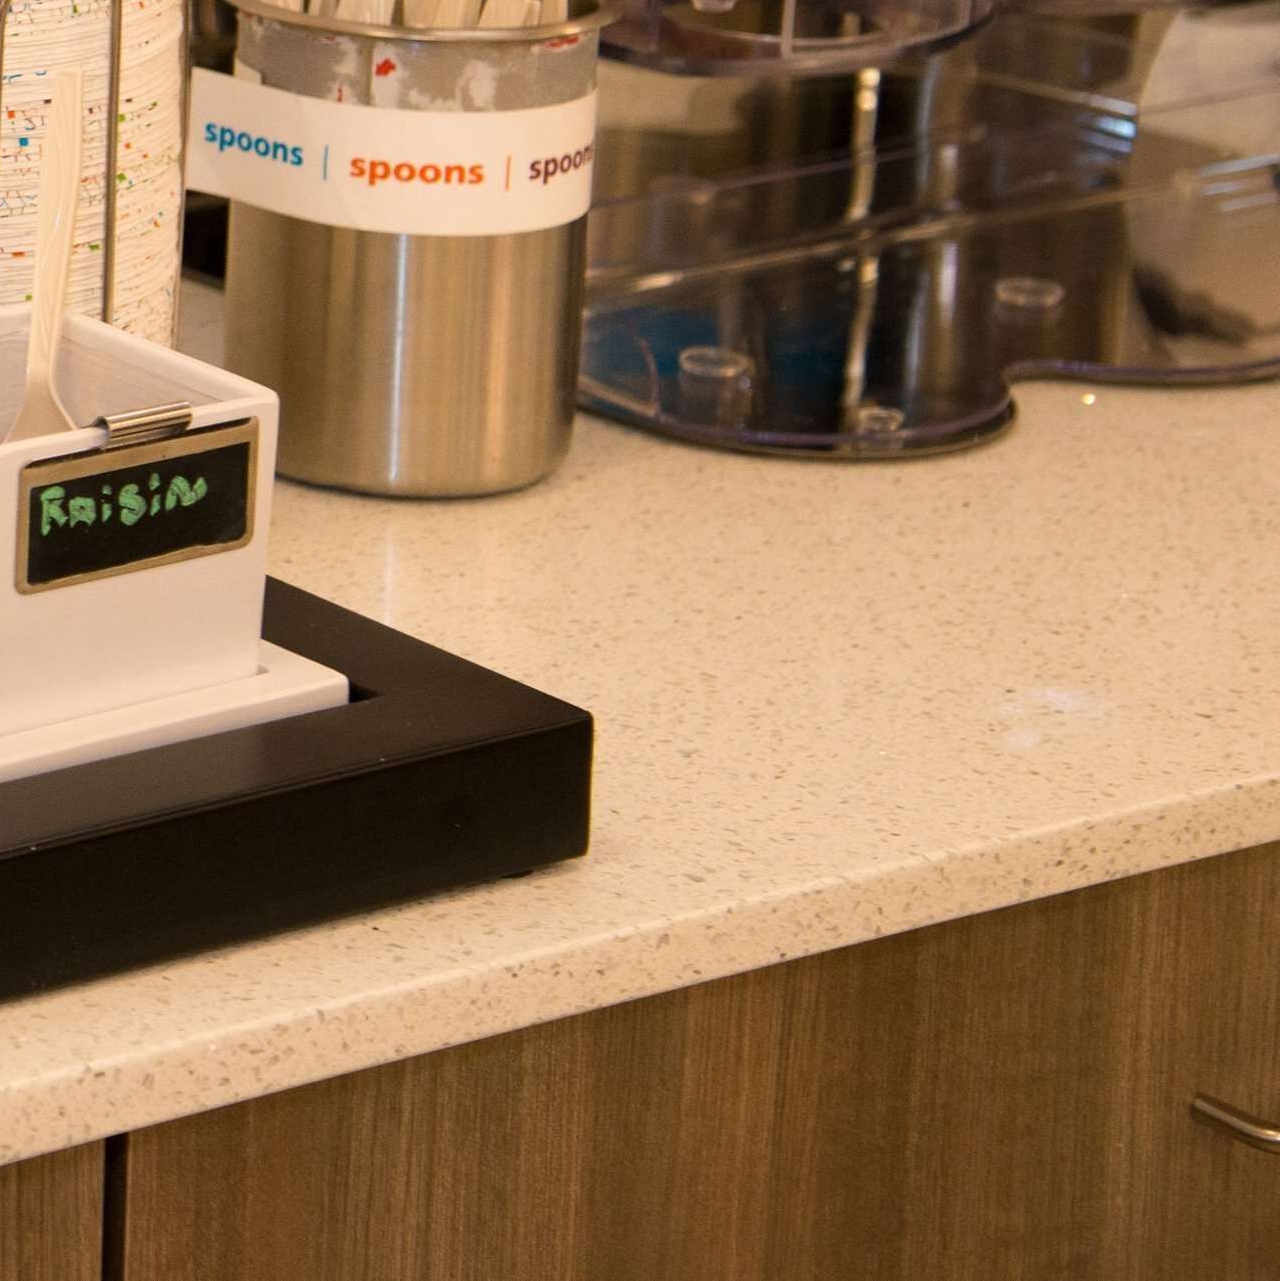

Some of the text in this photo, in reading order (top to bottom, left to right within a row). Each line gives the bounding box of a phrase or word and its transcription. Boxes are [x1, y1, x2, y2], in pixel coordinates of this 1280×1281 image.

[205, 122, 593, 186] spoons spoons spoon
